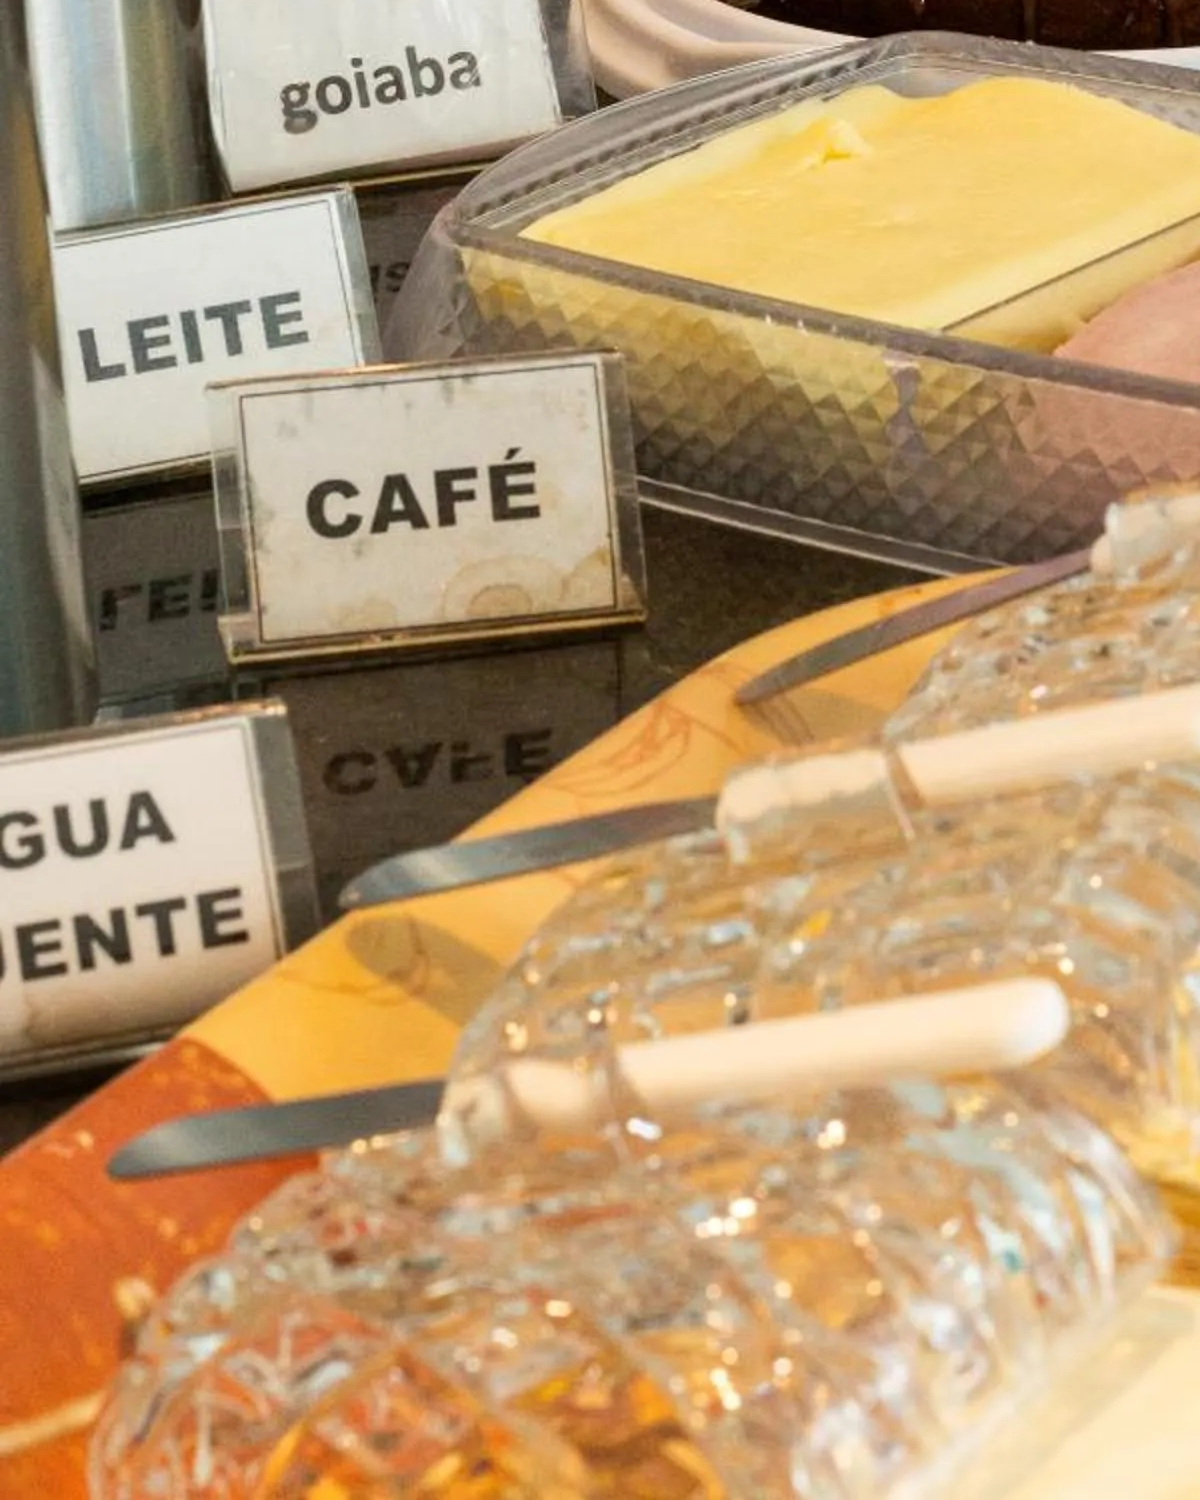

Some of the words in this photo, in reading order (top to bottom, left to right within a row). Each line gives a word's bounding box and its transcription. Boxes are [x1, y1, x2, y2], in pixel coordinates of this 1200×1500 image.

[281, 46, 482, 134] goiaba
[79, 291, 310, 383] LEITE
[306, 449, 541, 540] CAFÉ
[0, 791, 176, 870] GUA
[0, 887, 249, 983] ENTE
